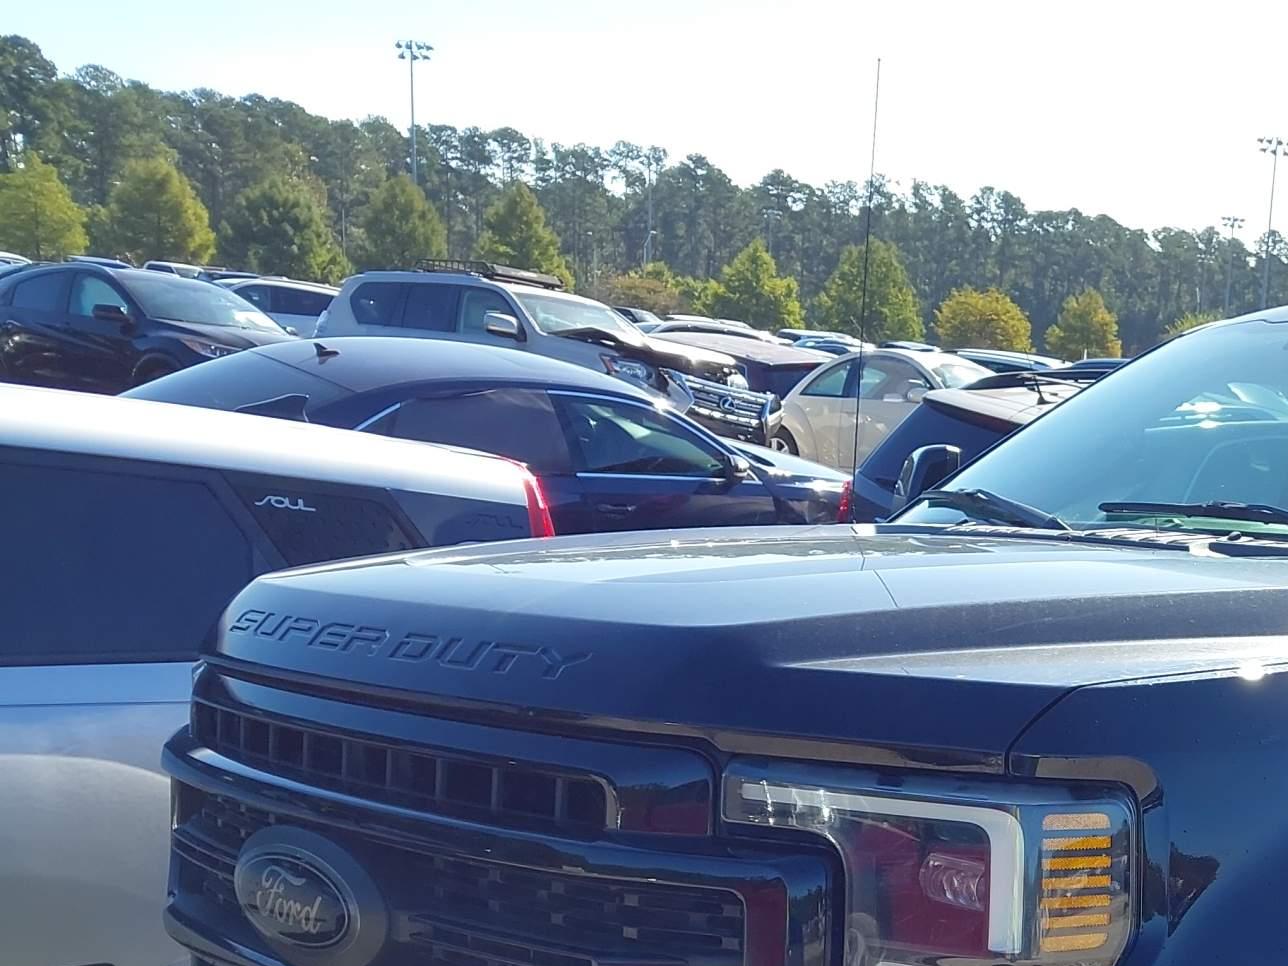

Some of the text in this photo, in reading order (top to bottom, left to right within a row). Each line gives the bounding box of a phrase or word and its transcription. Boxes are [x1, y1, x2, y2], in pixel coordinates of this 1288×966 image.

[253, 495, 317, 512] SOUL
[229, 609, 593, 680] SUPER DUTY
[256, 865, 323, 934] Ford
